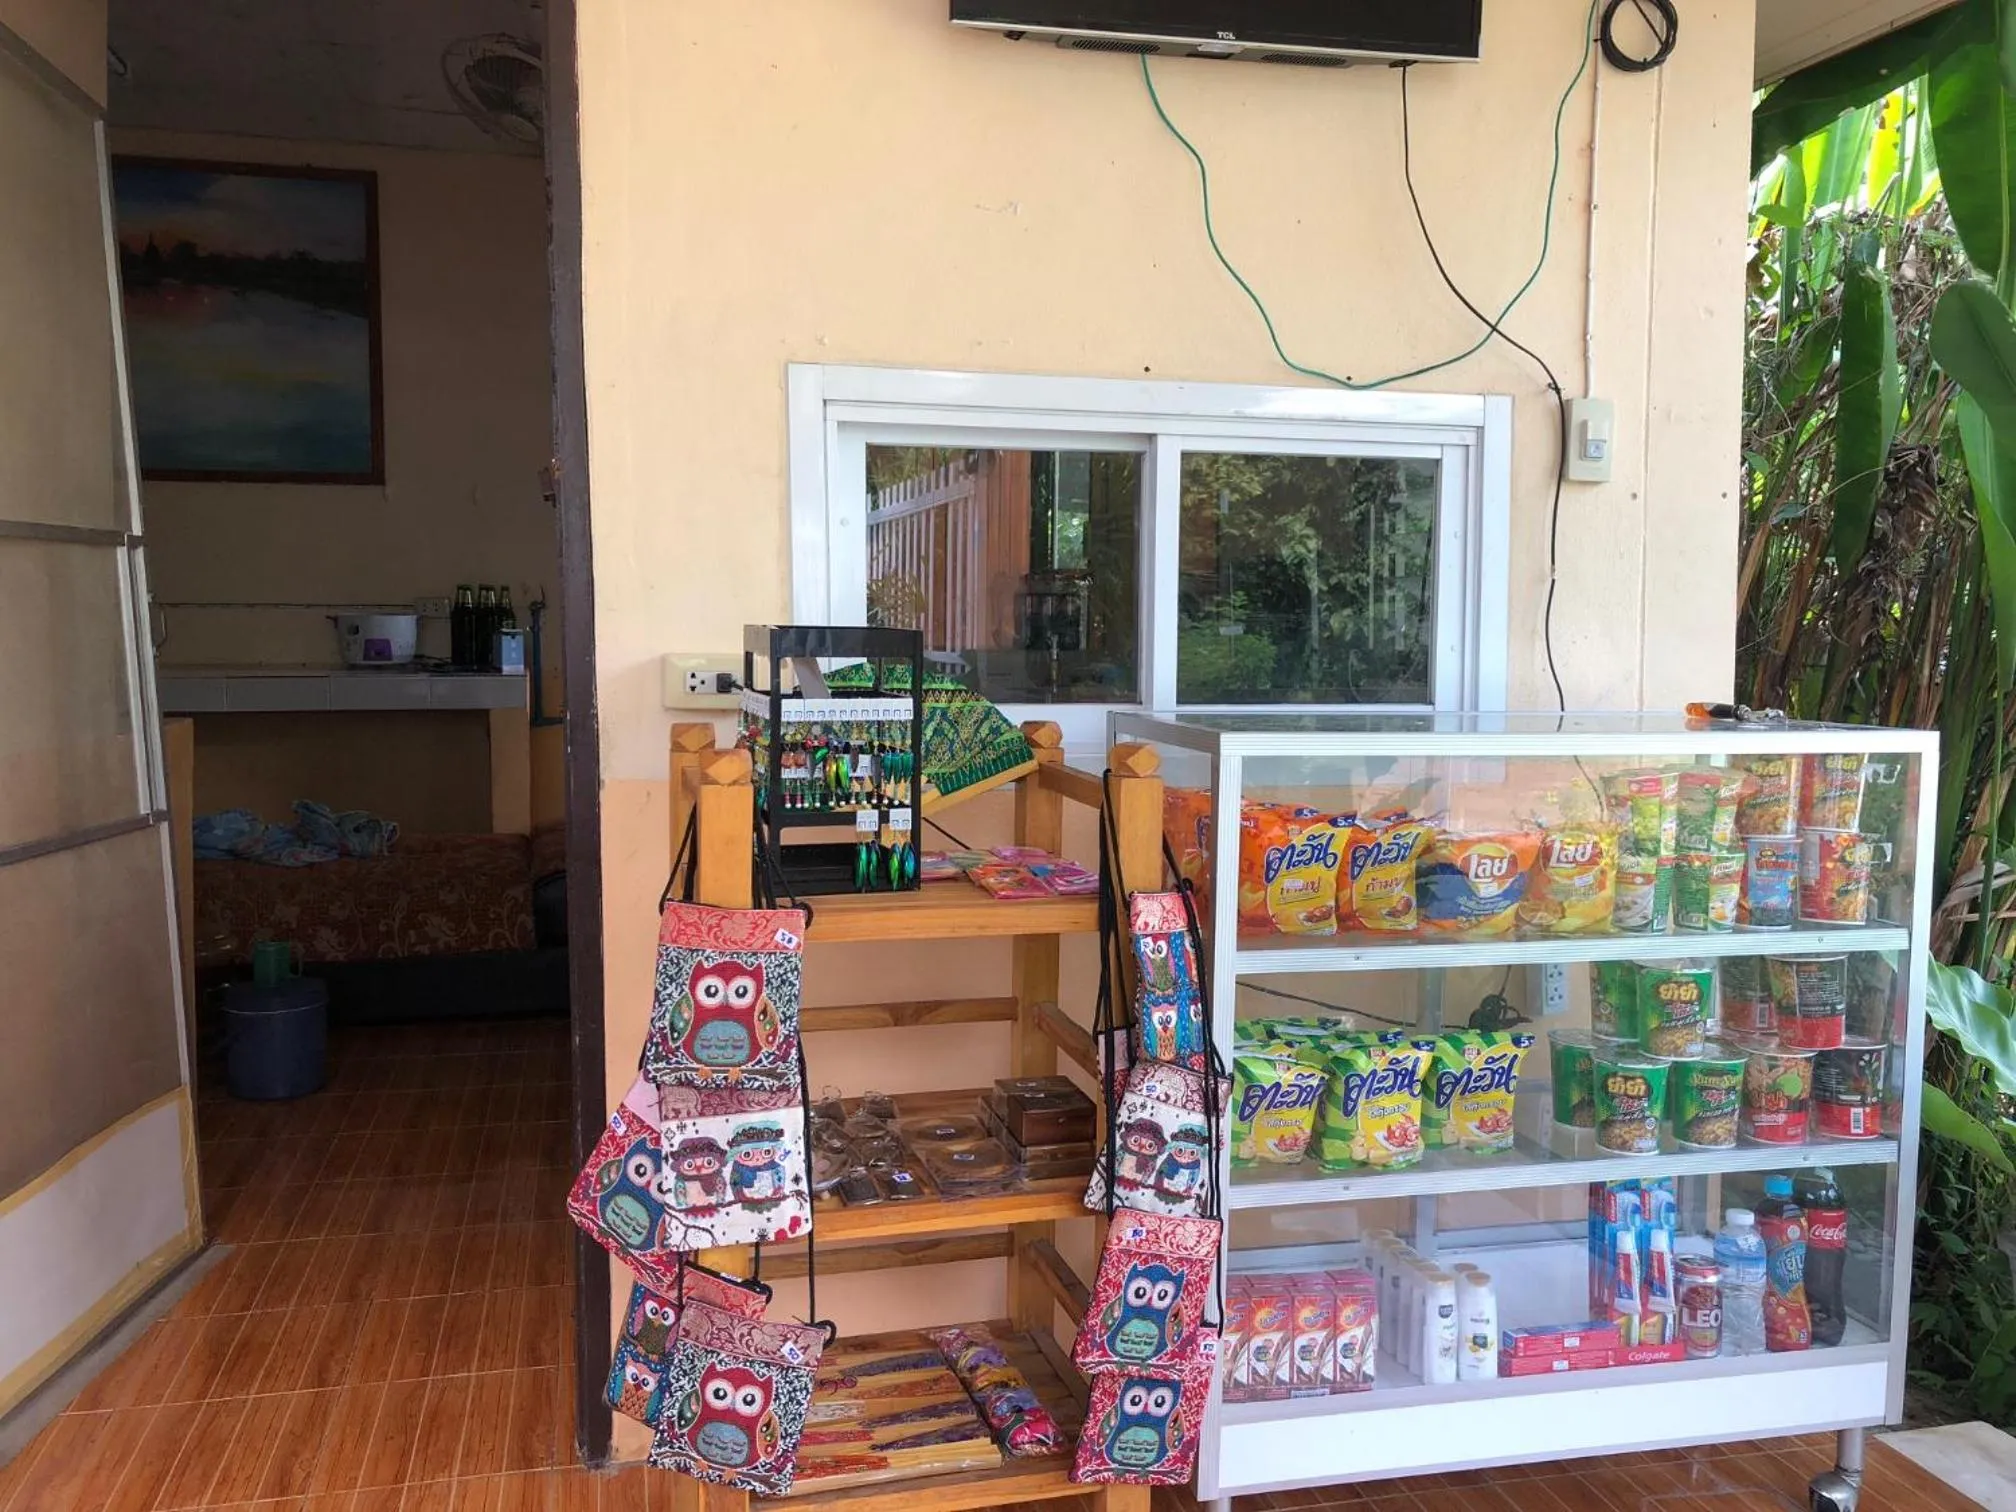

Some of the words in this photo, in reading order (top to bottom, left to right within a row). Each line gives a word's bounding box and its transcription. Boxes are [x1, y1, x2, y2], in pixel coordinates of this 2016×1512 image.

[1217, 31, 1236, 40] TCL
[1264, 832, 1338, 884] ตะวัน
[1238, 1072, 1328, 1123] ตะวัน
[1343, 1053, 1422, 1119] ตะวัน
[1434, 1052, 1519, 1110] ตะวัน
[1682, 1307, 1721, 1328] LEO
[1628, 1349, 1671, 1363] Colgate
